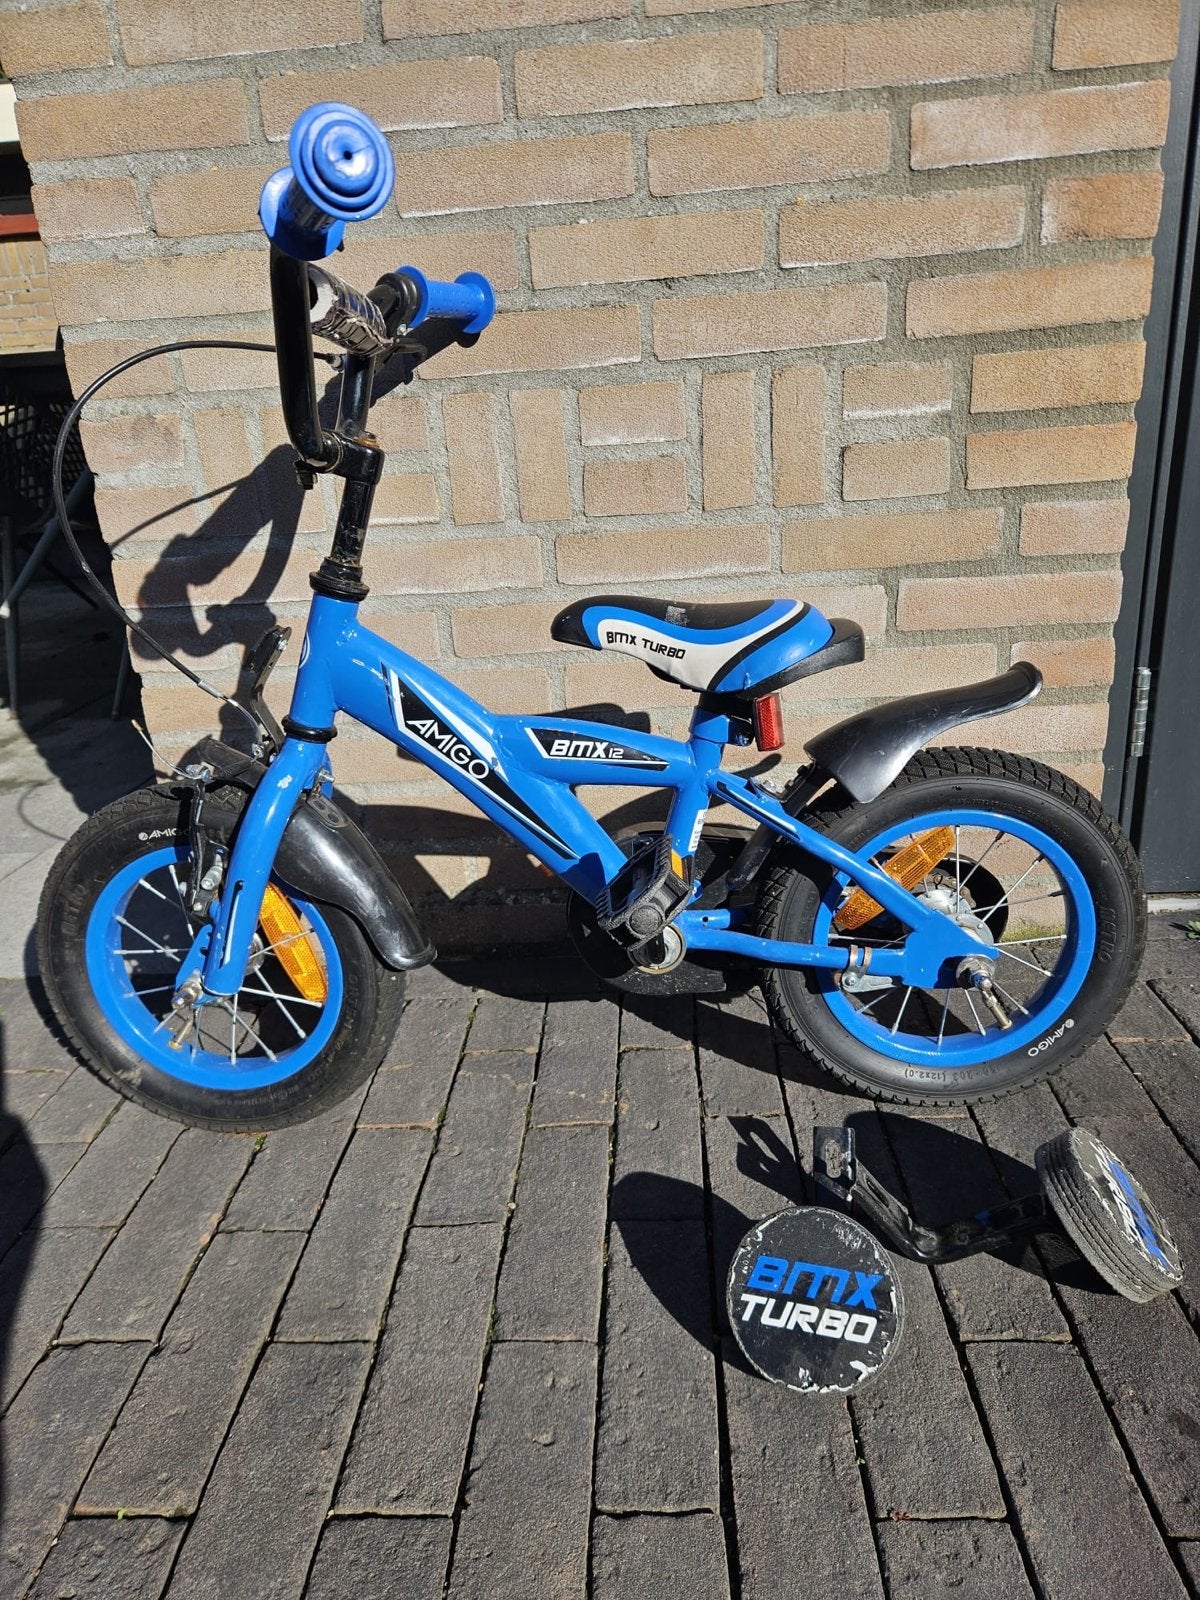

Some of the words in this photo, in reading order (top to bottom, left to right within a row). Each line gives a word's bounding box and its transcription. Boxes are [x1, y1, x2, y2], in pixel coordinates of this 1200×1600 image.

[606, 631, 637, 646] BMX
[642, 638, 686, 660] TURBO
[407, 719, 489, 779] AMIGO
[550, 740, 609, 758] BMX
[609, 748, 624, 759] 12
[1028, 1027, 1066, 1057] AMIGO
[747, 1254, 884, 1311] BMX
[740, 1293, 878, 1344] TURBO
